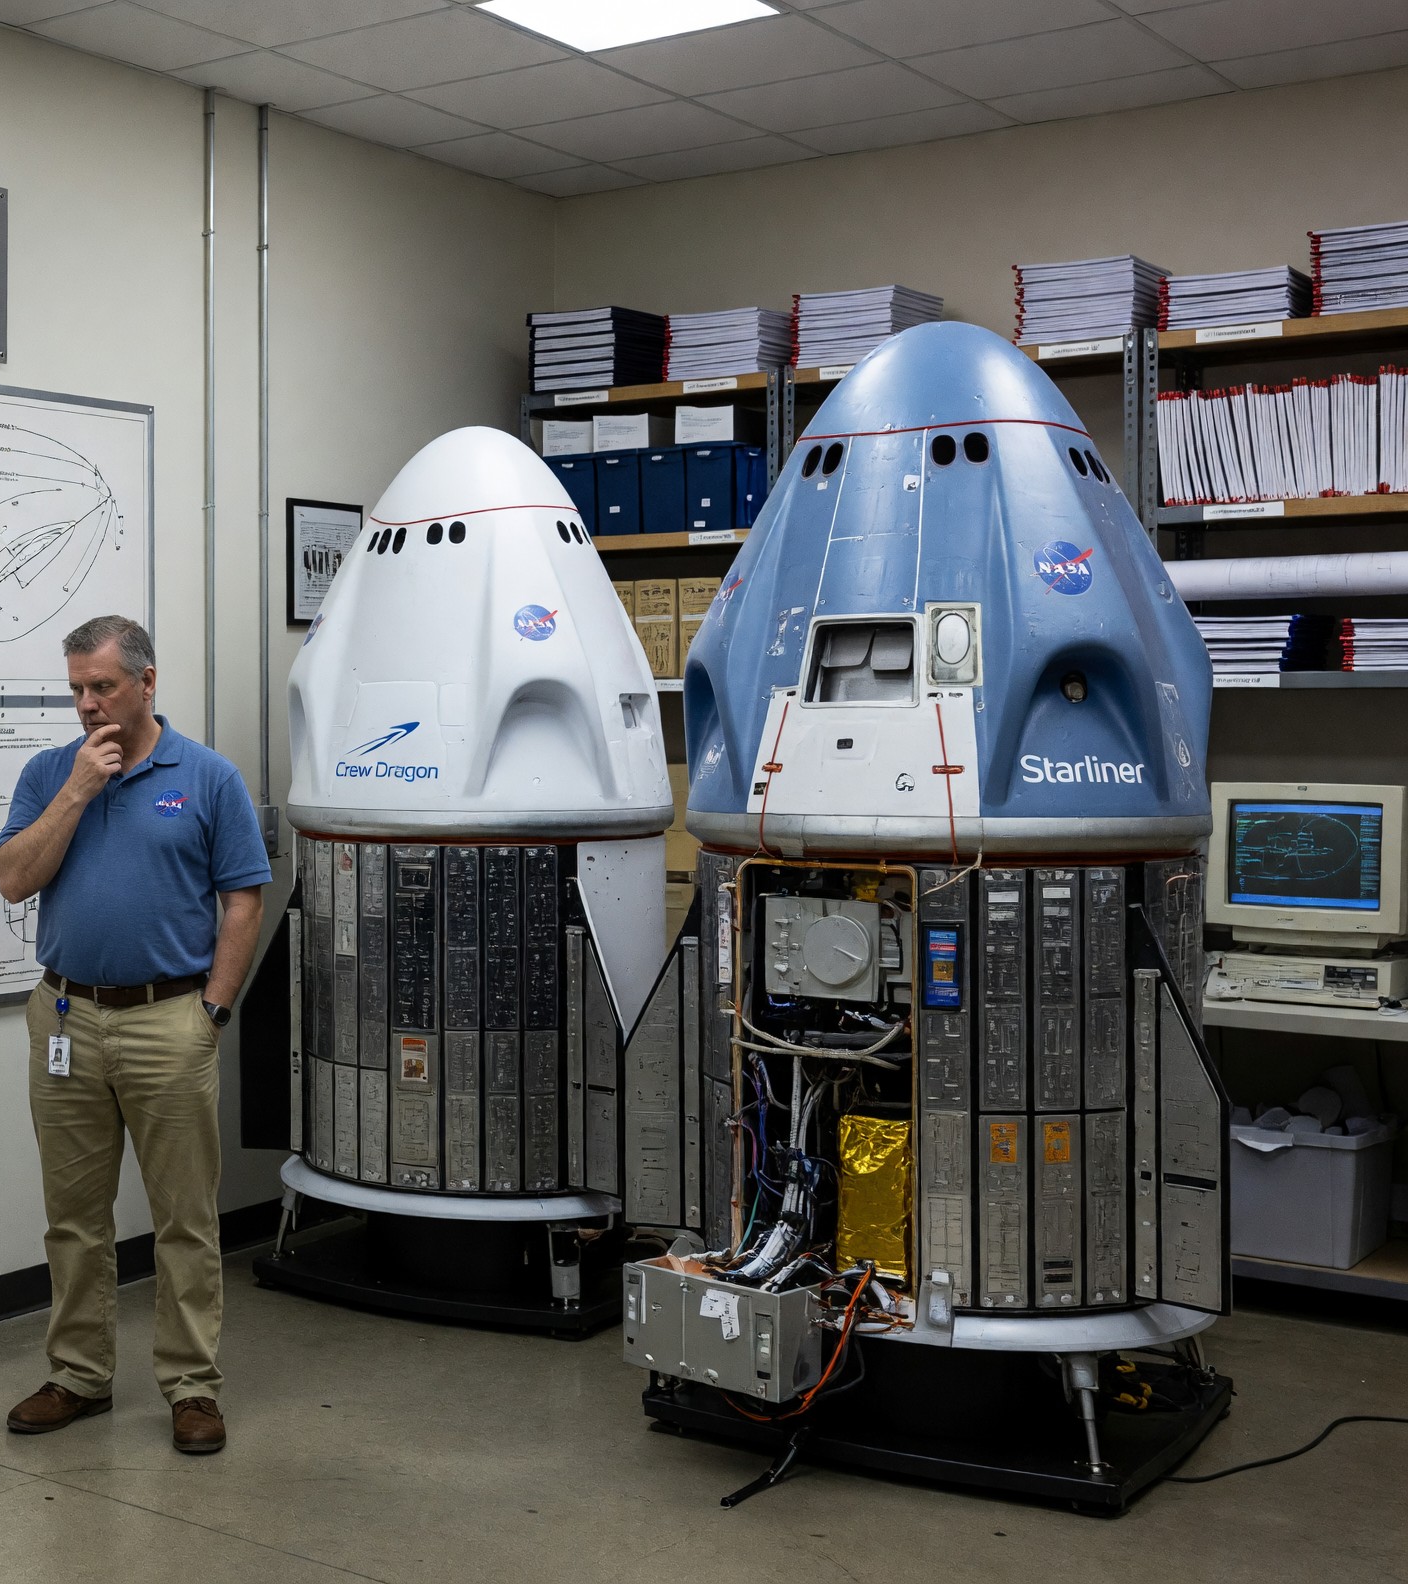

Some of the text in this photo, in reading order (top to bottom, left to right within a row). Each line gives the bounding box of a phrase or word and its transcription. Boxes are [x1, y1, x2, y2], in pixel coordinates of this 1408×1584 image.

[1038, 561, 1090, 575] NASA
[335, 761, 438, 782] Crew Dragon
[1020, 754, 1145, 783] Starliner
